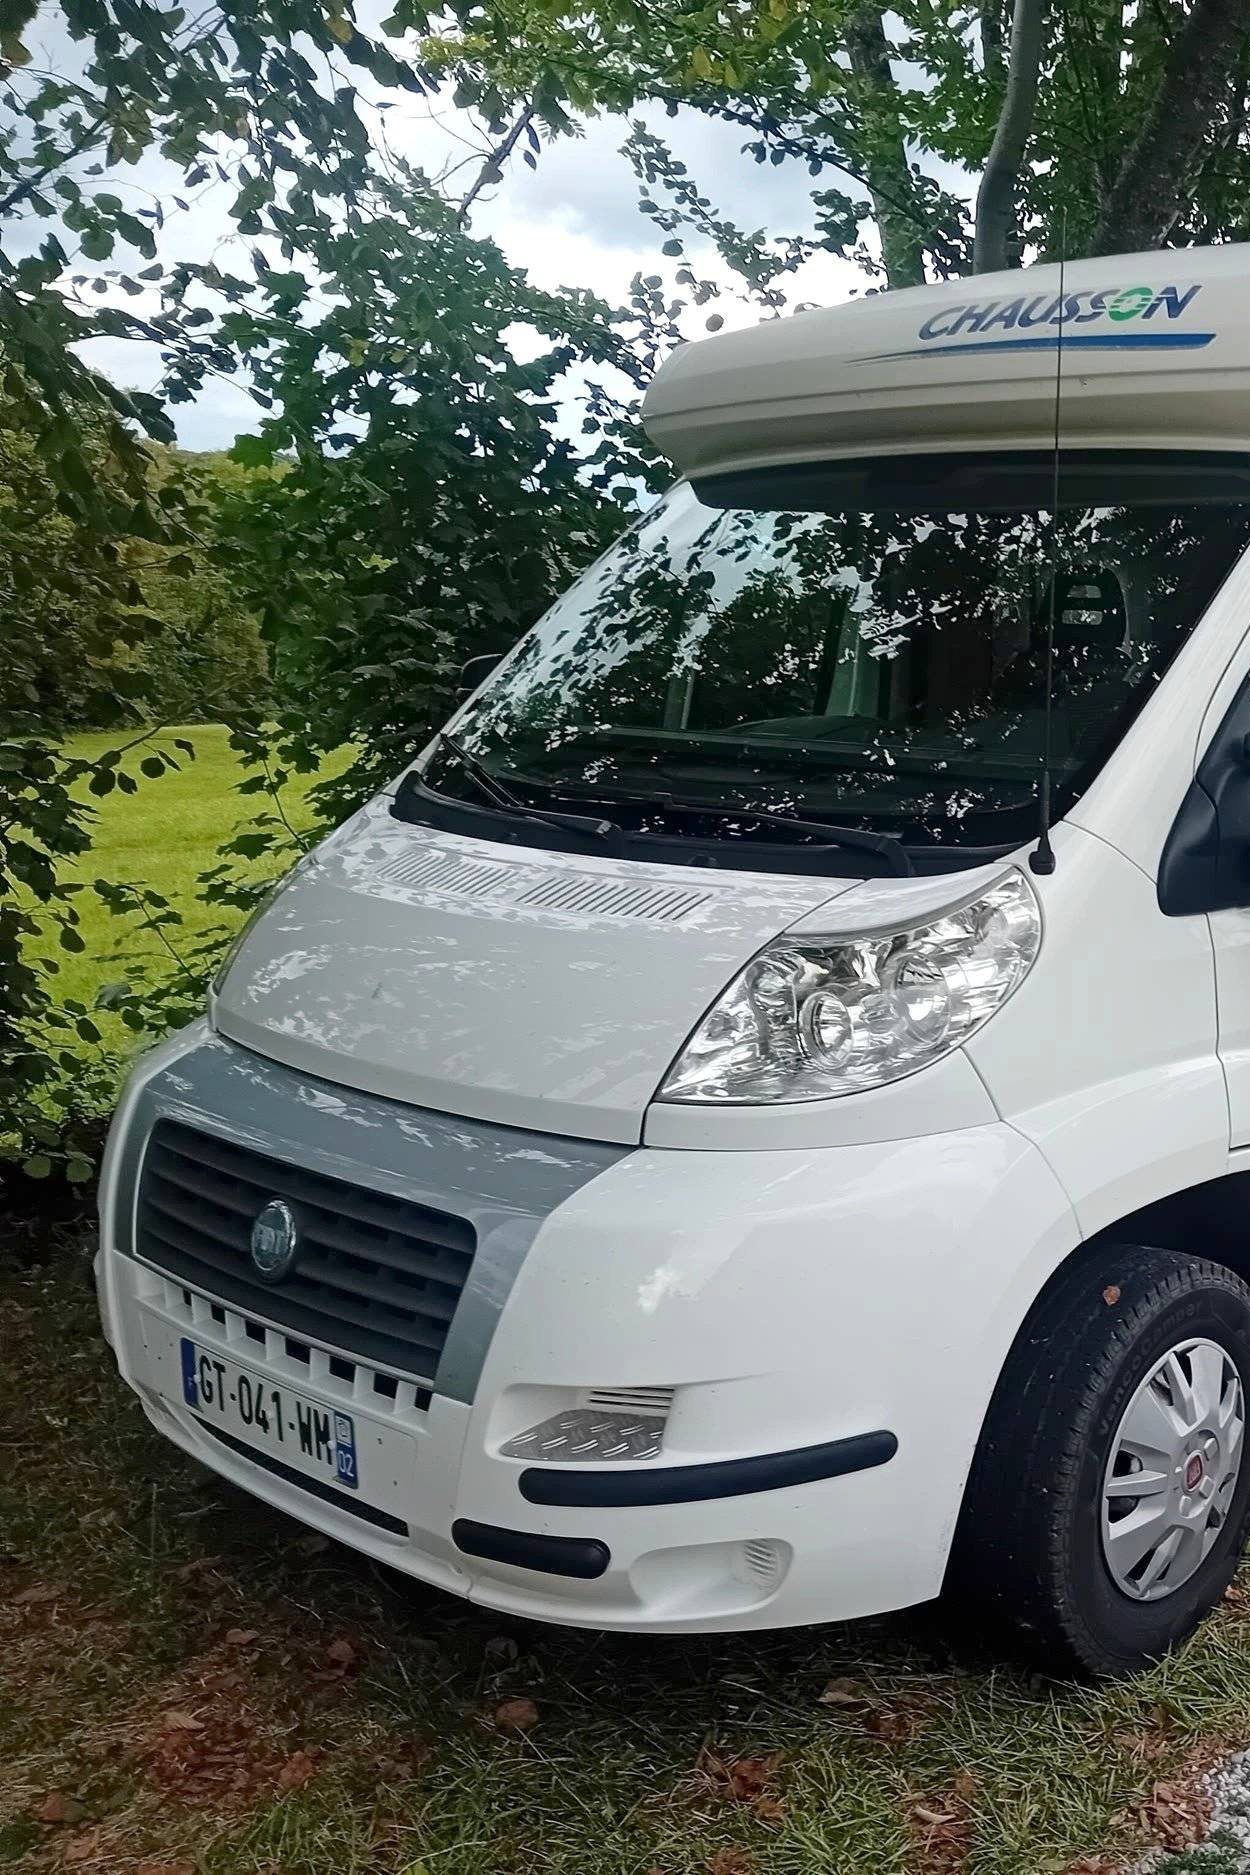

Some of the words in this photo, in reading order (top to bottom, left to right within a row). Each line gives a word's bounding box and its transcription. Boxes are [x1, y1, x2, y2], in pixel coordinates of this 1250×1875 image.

[918, 285, 1203, 341] CHAUSSON
[199, 1354, 333, 1466] GT-041-WM
[338, 1450, 355, 1478] 02
